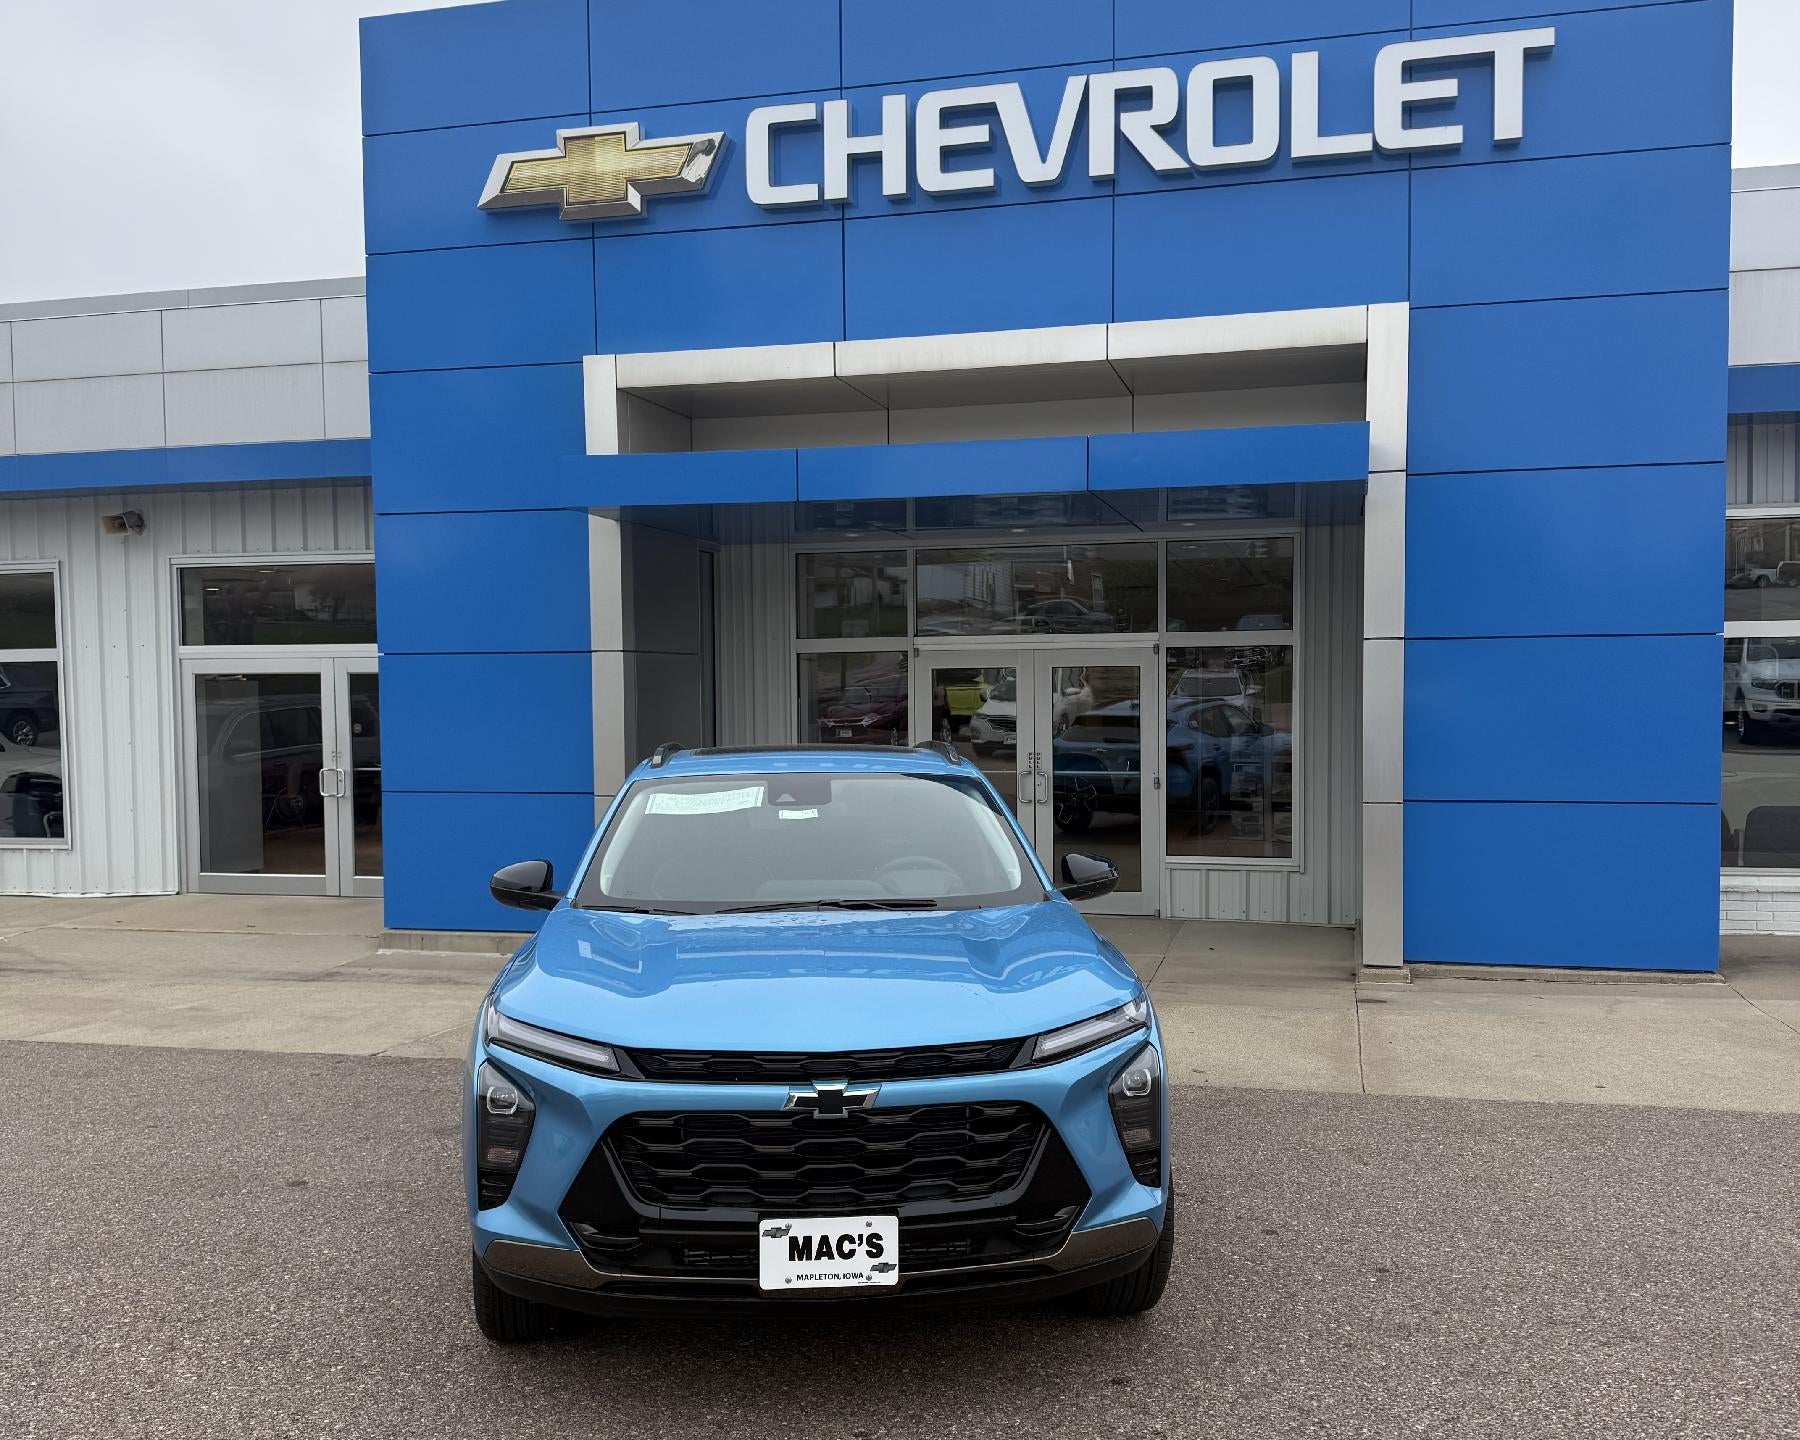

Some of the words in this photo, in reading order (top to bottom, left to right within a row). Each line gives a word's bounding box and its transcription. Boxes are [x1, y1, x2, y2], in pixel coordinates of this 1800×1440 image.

[745, 26, 1556, 208] CHEVROLET
[788, 1232, 884, 1261] MAC'S
[796, 1273, 842, 1282] MAPLETON,
[843, 1272, 864, 1280] IOWA
